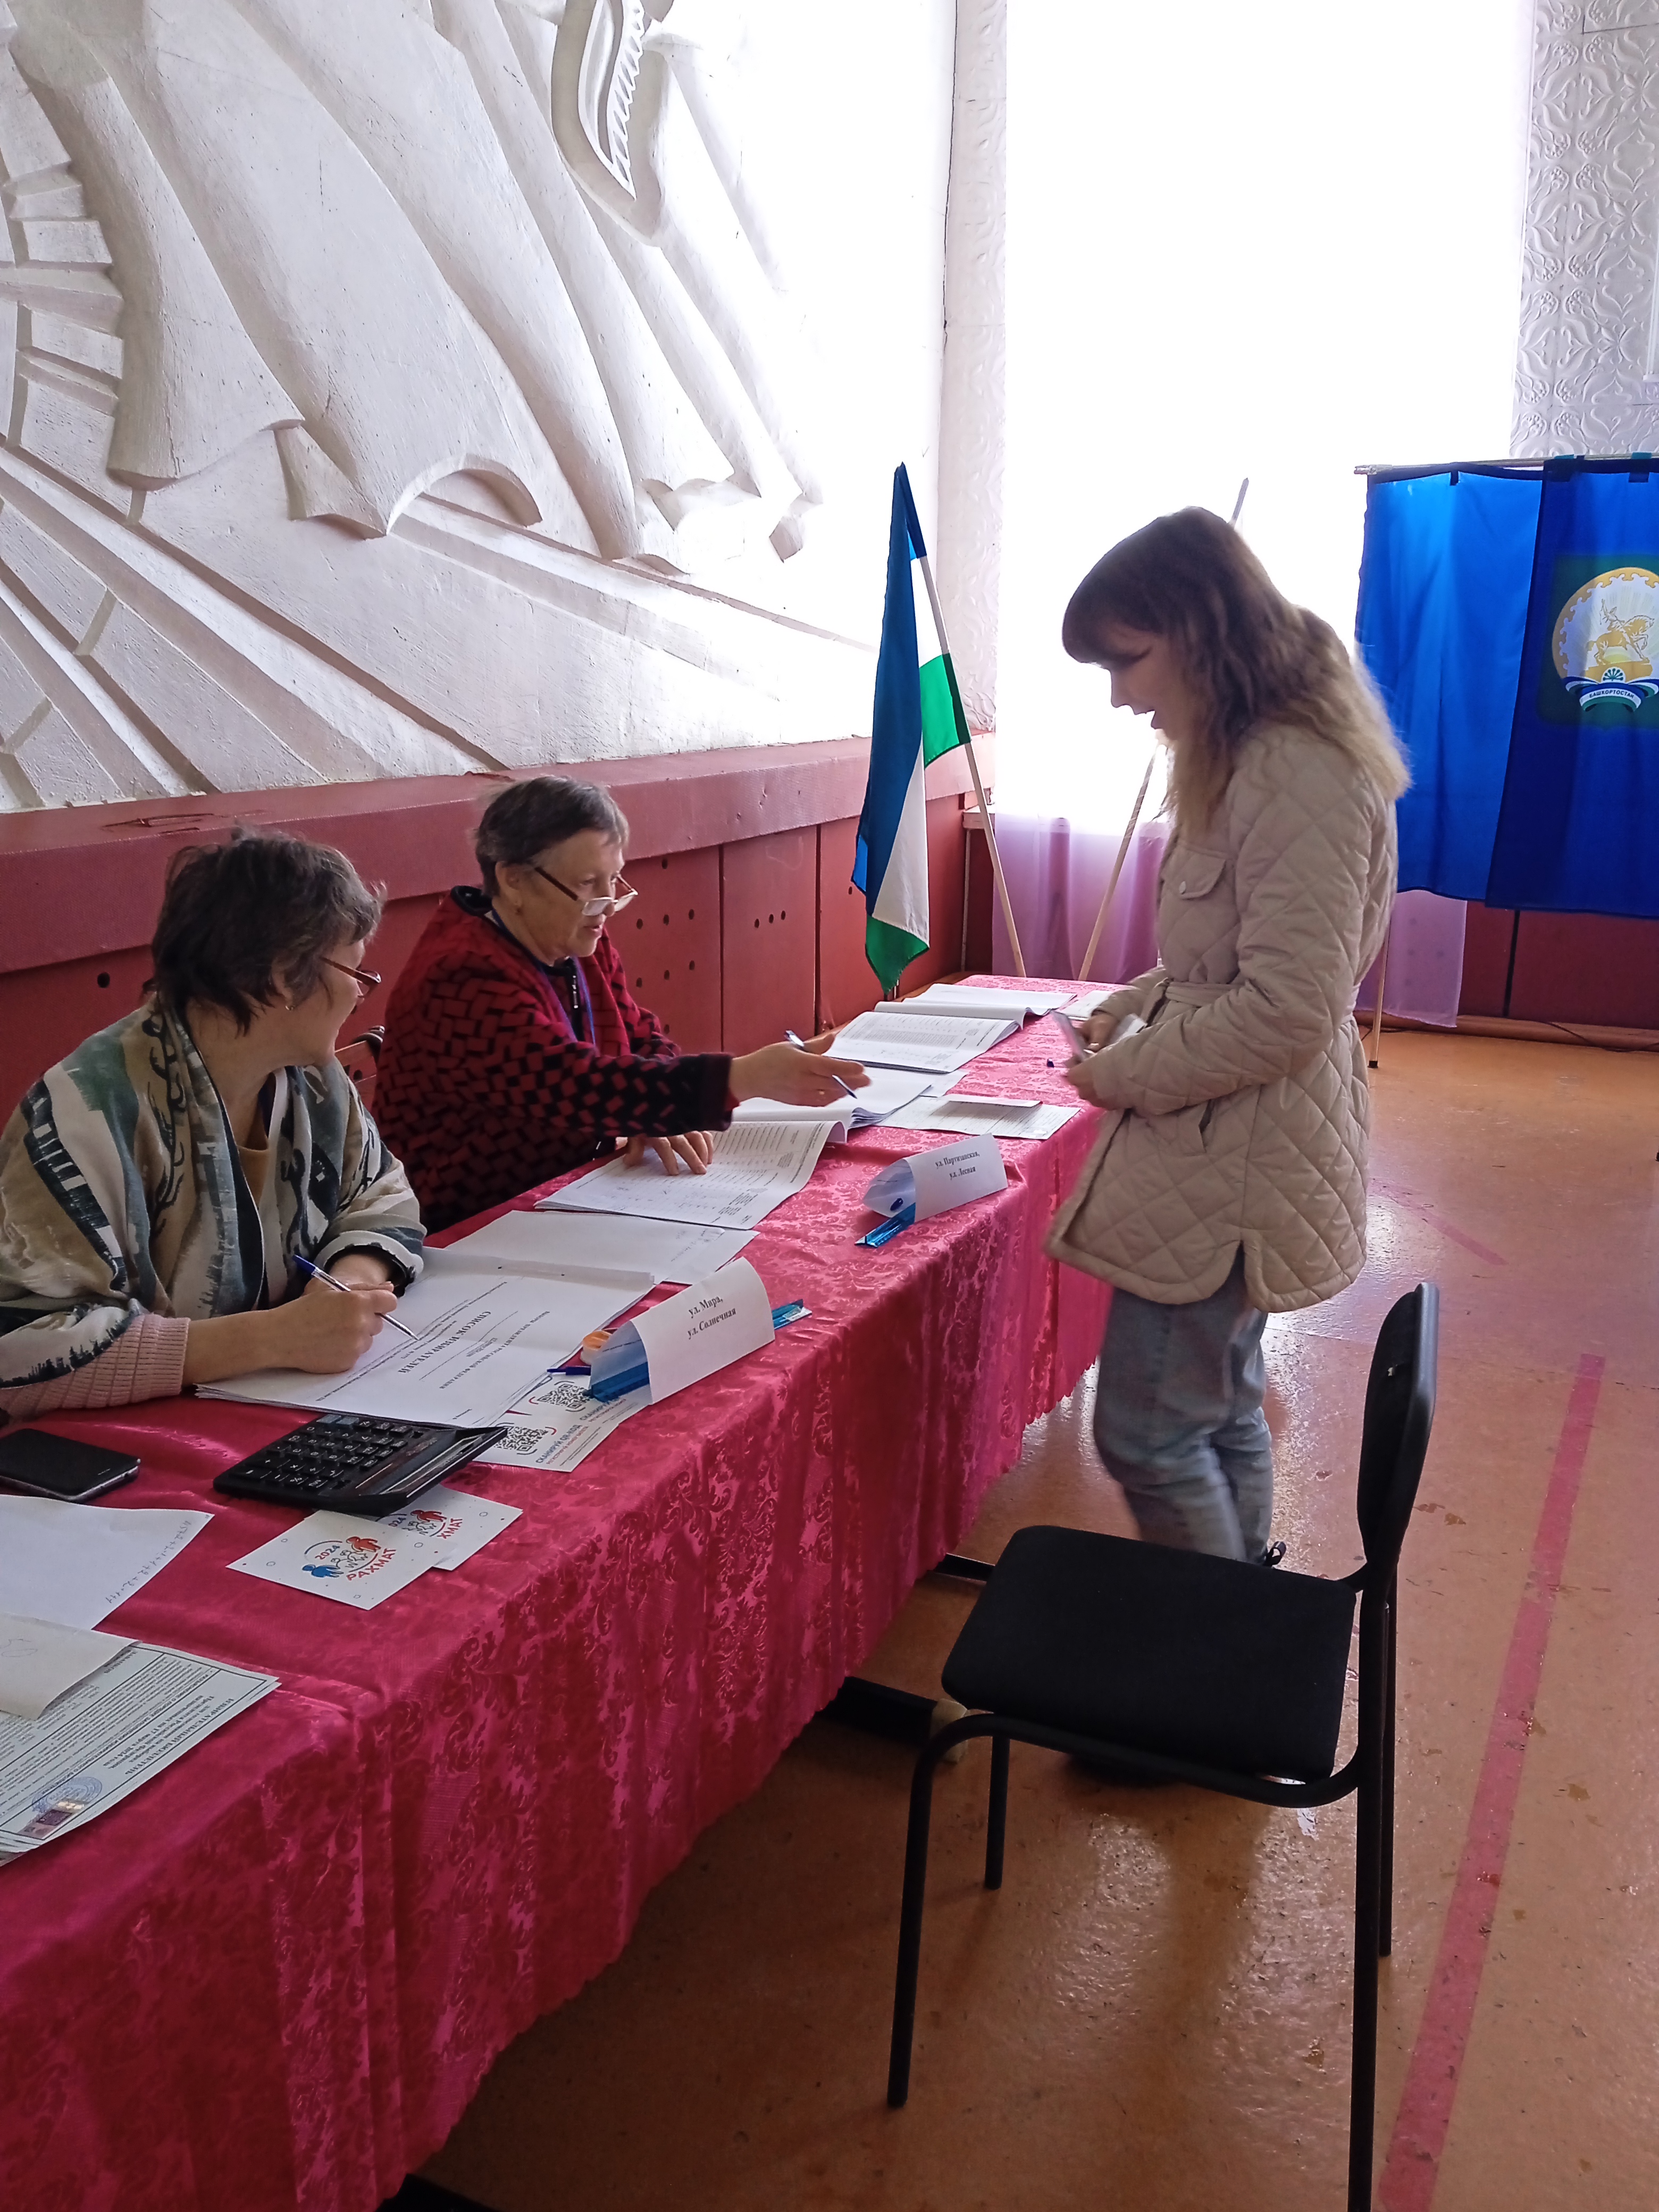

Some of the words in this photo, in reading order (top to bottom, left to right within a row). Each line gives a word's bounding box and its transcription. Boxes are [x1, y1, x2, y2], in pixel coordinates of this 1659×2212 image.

[1589, 690, 1635, 699] БАШКОРТОСТАН
[944, 1151, 980, 1165] Партизанская,
[958, 1166, 976, 1176] Лесная
[688, 1306, 700, 1319] ул.
[699, 1295, 724, 1310] Мира,
[454, 1310, 492, 1335] СПИСОК
[688, 1328, 698, 1339] ул.
[699, 1308, 736, 1331] Солнечная
[397, 1336, 460, 1373] ИЗБИРАТЕЛЕЙ
[535, 1440, 564, 1463] СКАНИРУЙ
[389, 1517, 406, 1527] 024
[437, 1518, 463, 1539] ХМАТ
[315, 1545, 340, 1560] 2024
[346, 1548, 397, 1581] РАХМАТ
